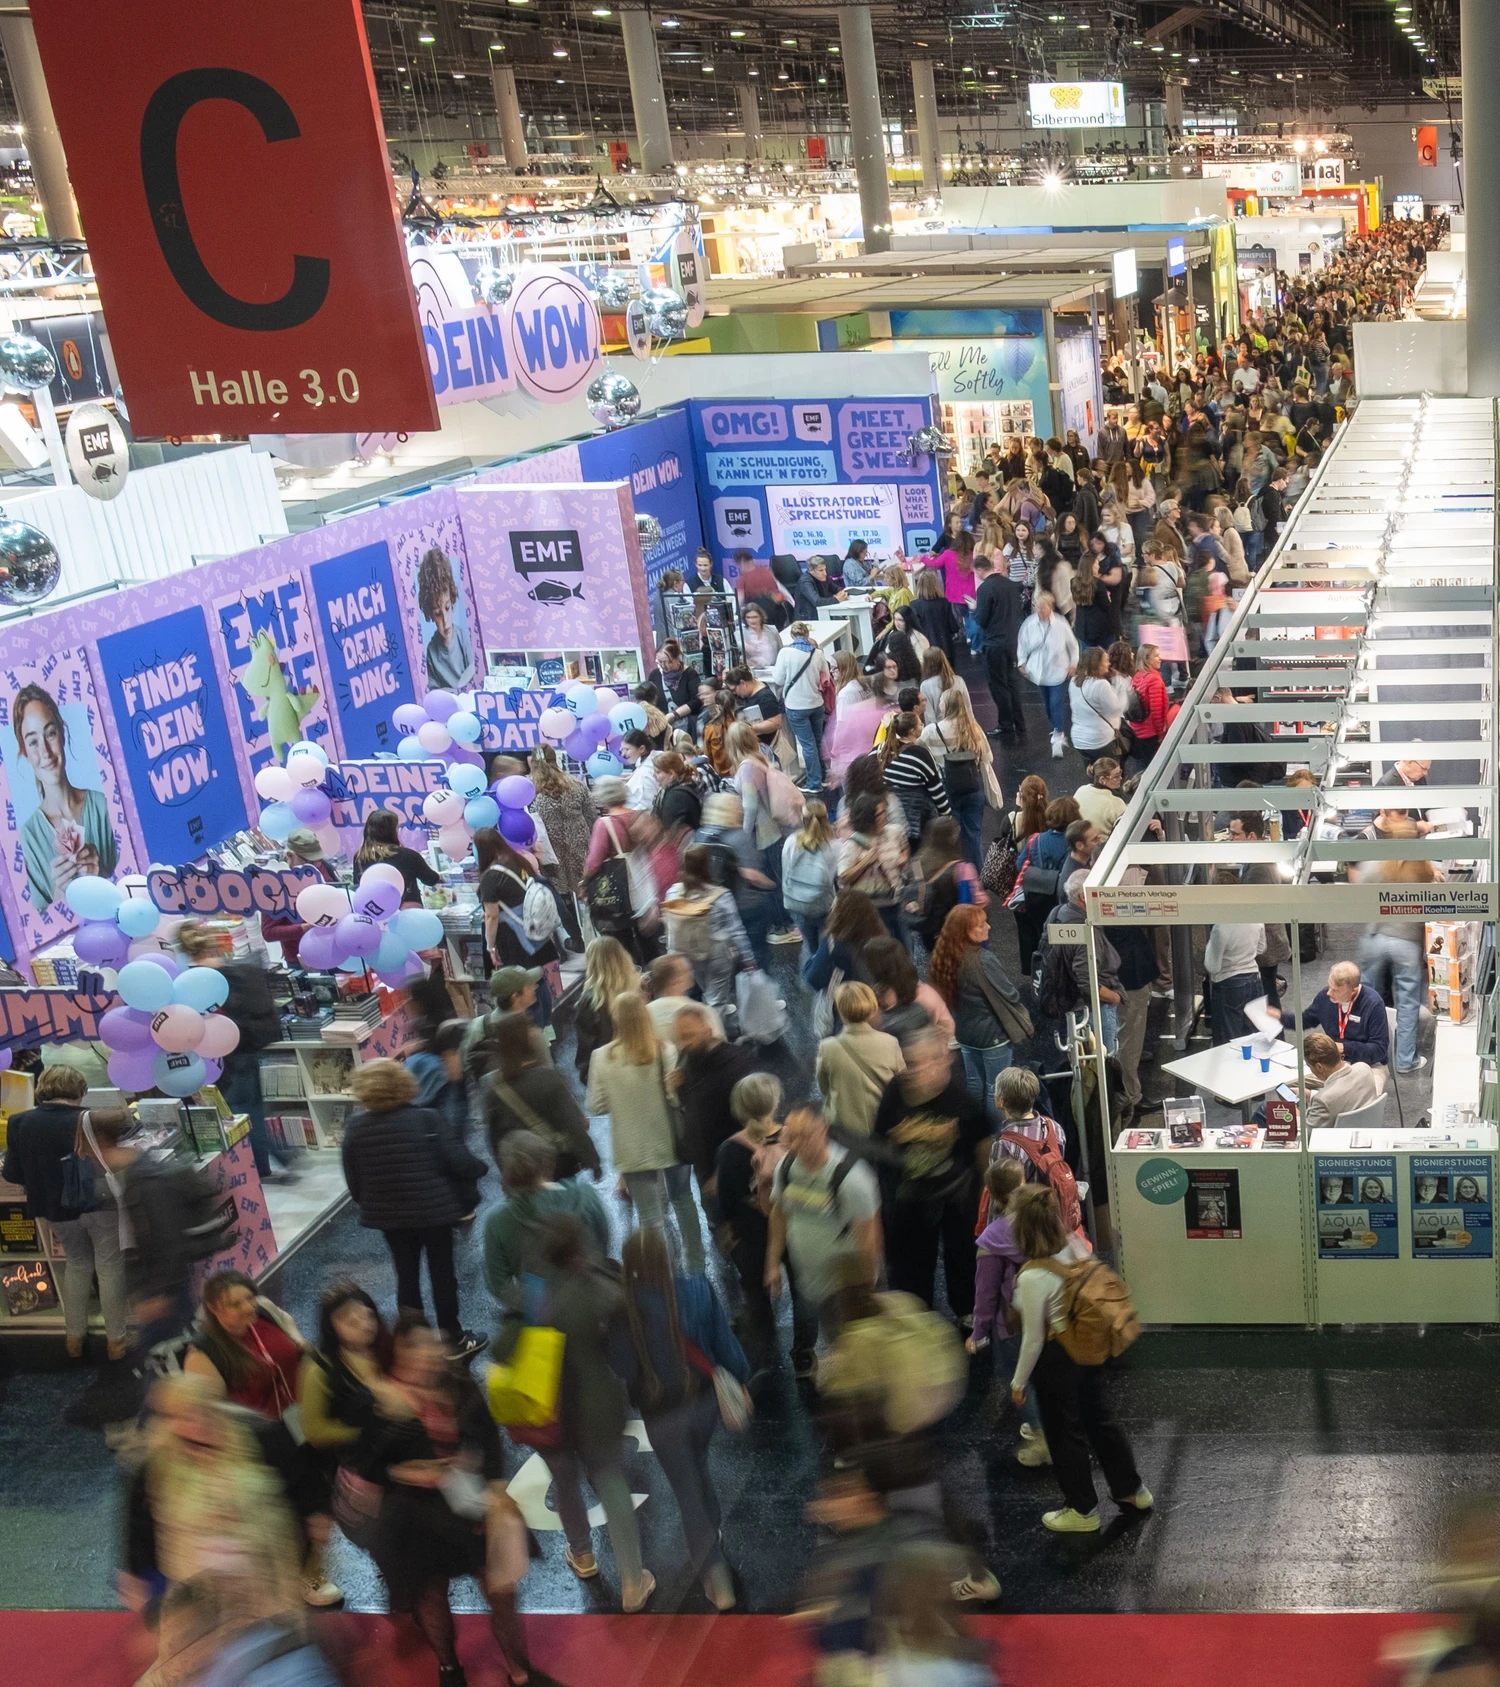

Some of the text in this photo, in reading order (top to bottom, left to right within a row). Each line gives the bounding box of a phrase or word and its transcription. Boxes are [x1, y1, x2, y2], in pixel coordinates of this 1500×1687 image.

[1033, 112, 1105, 126] Silbermund
[140, 67, 331, 331] C
[680, 260, 695, 279] EMF
[517, 301, 601, 374] WOW.
[959, 346, 988, 368] Me
[191, 366, 360, 406] Halle 3.0
[953, 367, 1005, 395] Softly
[712, 412, 780, 436] OMG!
[805, 414, 820, 424] EMF
[851, 410, 912, 430] MEET,
[84, 431, 109, 452] EMF
[718, 455, 734, 468] ÄH
[633, 457, 683, 496] DEIN WOW.
[717, 468, 828, 480] KANN ICH FOTO?
[905, 496, 928, 504] WHAT
[728, 512, 748, 522] EMF
[789, 509, 882, 521] SPRECHSTUNDE
[908, 511, 930, 519] HAVE
[520, 540, 572, 563] EMF
[328, 583, 386, 634] MACH
[341, 622, 389, 671] DEIN
[121, 655, 203, 717] FINDE
[350, 661, 401, 709] DING.
[477, 693, 553, 721] PLAY
[140, 701, 206, 760] DEIN
[148, 746, 219, 805] WOW.
[341, 765, 443, 794] DEINE
[1379, 890, 1489, 904] Maximilian Verlag
[1392, 906, 1422, 914] Mittler
[1067, 930, 1076, 938] 10
[1318, 1159, 1392, 1167] SIGNIERSTUNDE
[1413, 1158, 1488, 1166] SIGNIERSTUNDE
[1140, 1168, 1179, 1188] GEWINN-
[1152, 1177, 1178, 1194] SPIEL!
[1323, 1216, 1366, 1228] AQUA
[1418, 1215, 1460, 1228] AQUA
